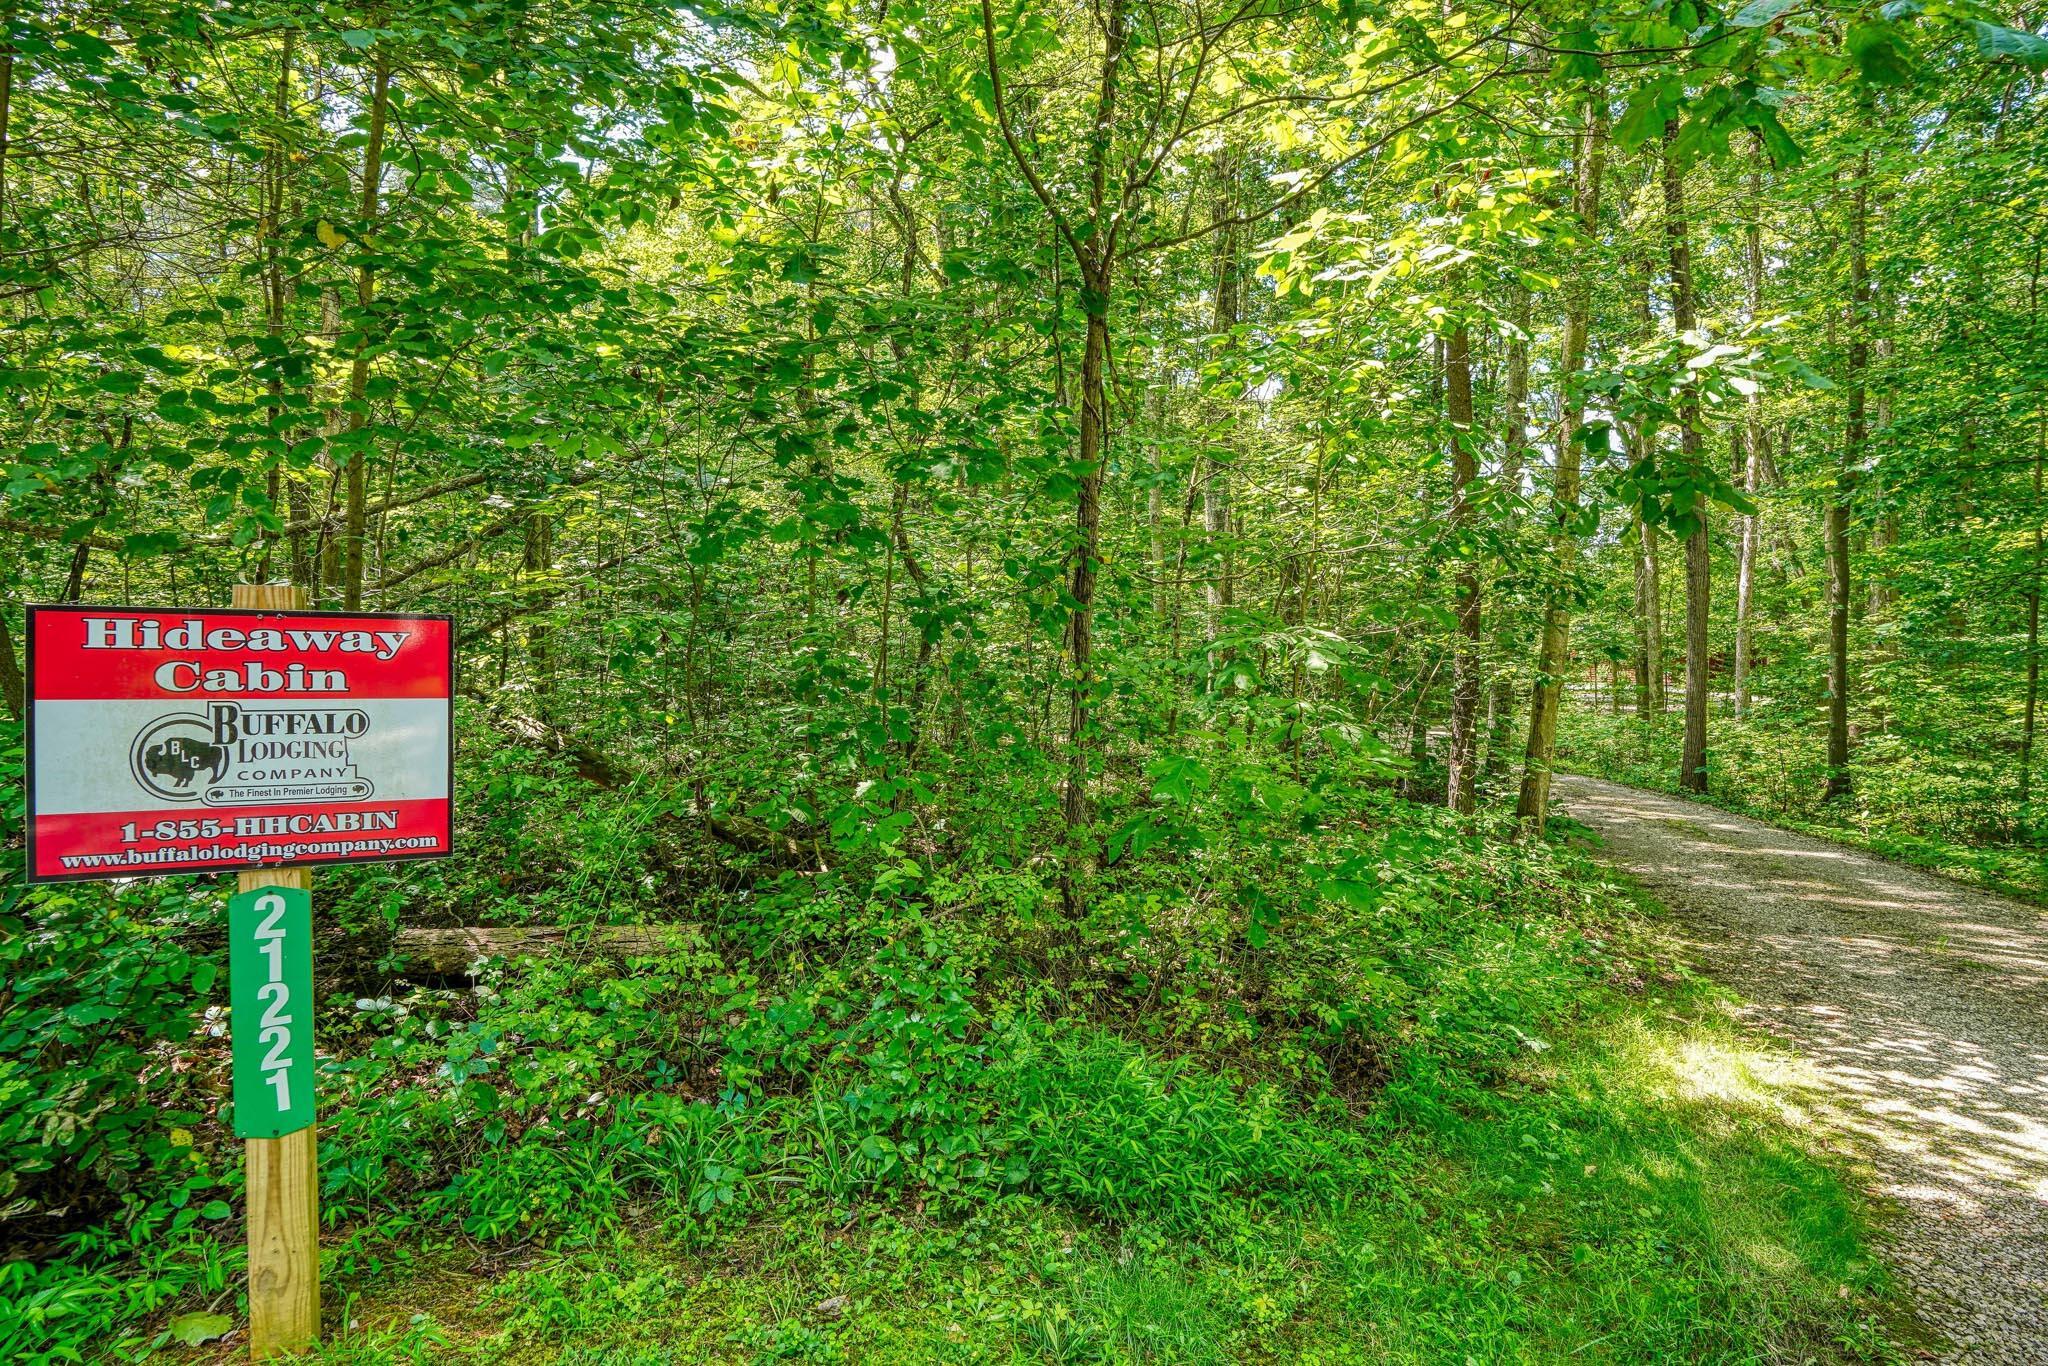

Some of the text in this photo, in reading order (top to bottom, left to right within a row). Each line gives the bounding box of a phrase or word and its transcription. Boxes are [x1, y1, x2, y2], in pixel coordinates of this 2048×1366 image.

[82, 618, 411, 660] Hideaway
[154, 661, 350, 692] Cabin
[212, 705, 367, 745] BUFFALO
[238, 739, 345, 763] LODGING
[237, 768, 348, 781] COMPANY
[229, 786, 347, 798] The Finest In Premier Lodging
[120, 811, 398, 843] 1-855-HHCABIN
[60, 834, 438, 869] www.buffalolodgingcompany.com
[253, 894, 293, 1112] 21221
